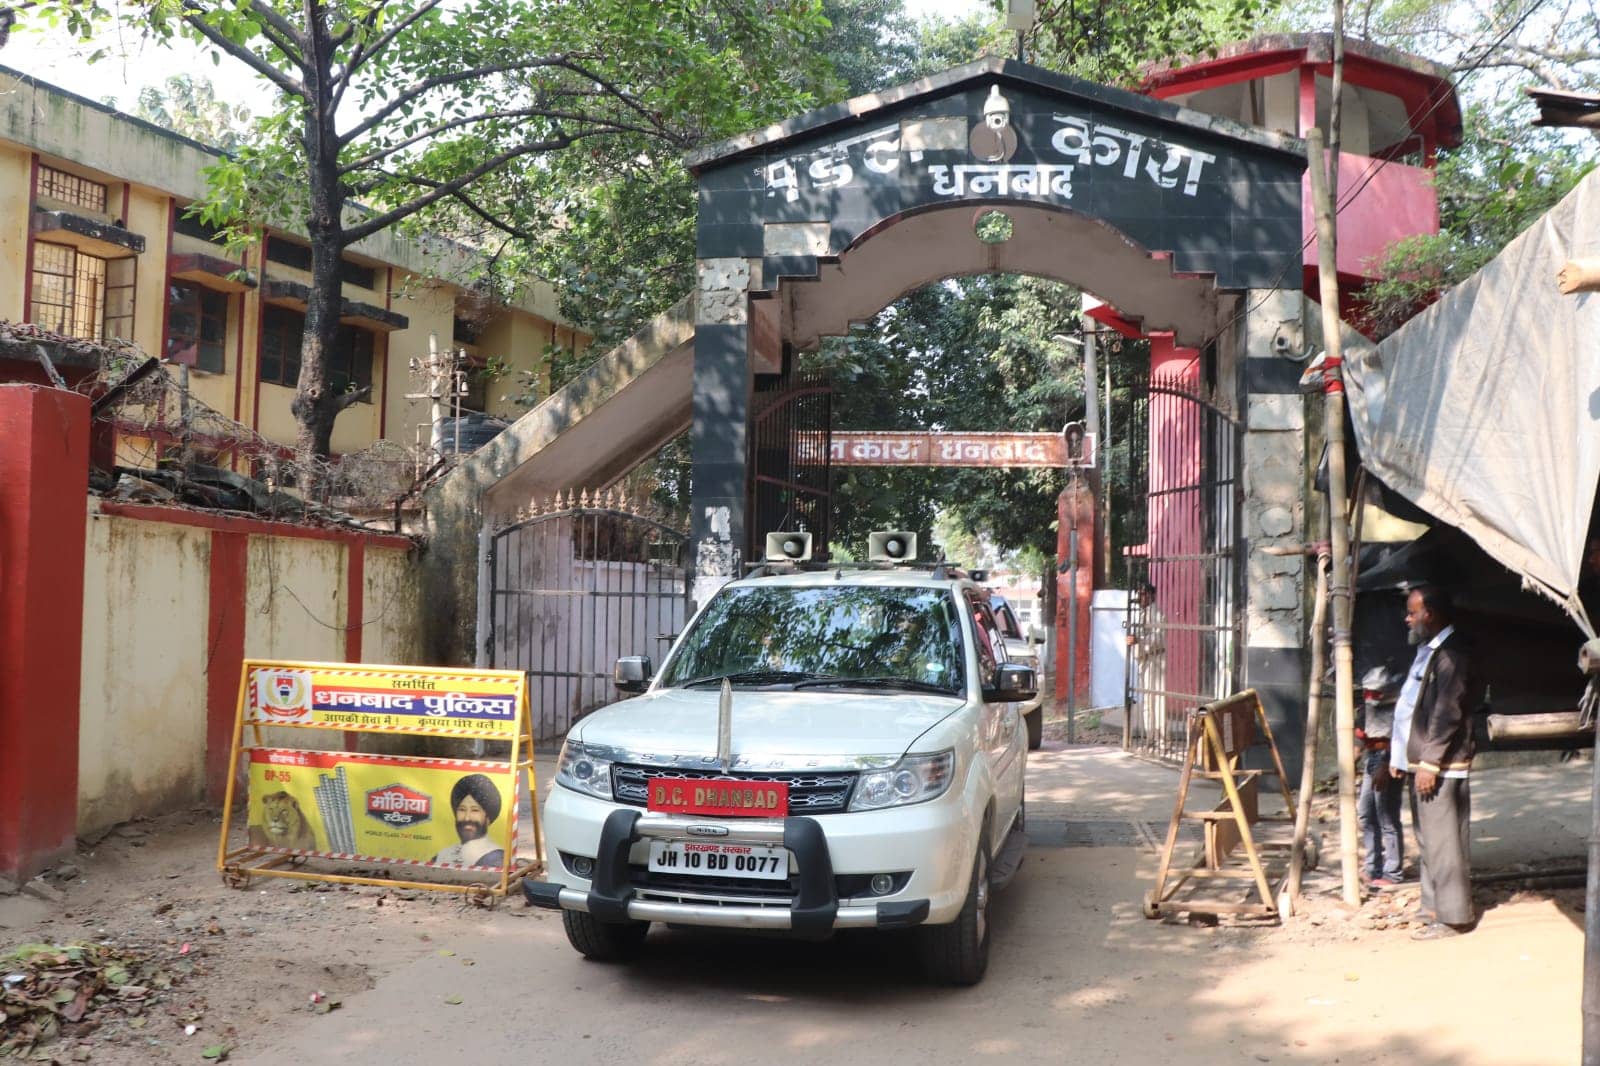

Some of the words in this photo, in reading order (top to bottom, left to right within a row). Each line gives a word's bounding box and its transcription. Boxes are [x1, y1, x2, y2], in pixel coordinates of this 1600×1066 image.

[1051, 112, 1217, 197] कारा
[928, 163, 1074, 199] धनबाद
[937, 438, 1047, 460] धनबाद
[392, 678, 436, 691] समर्पित
[315, 690, 414, 710] धनबाद
[421, 692, 513, 716] पुलिस
[324, 712, 358, 723] आपकी
[362, 713, 380, 724] सेवा
[418, 717, 450, 728] कृपया
[655, 786, 688, 806] D.C.
[695, 787, 777, 809] DHANBAD
[384, 811, 413, 823] स्टील
[722, 846, 752, 855] सरकार
[656, 851, 677, 867] JH
[684, 852, 700, 868] 10
[707, 853, 728, 870] BD
[735, 855, 779, 873] 0077
